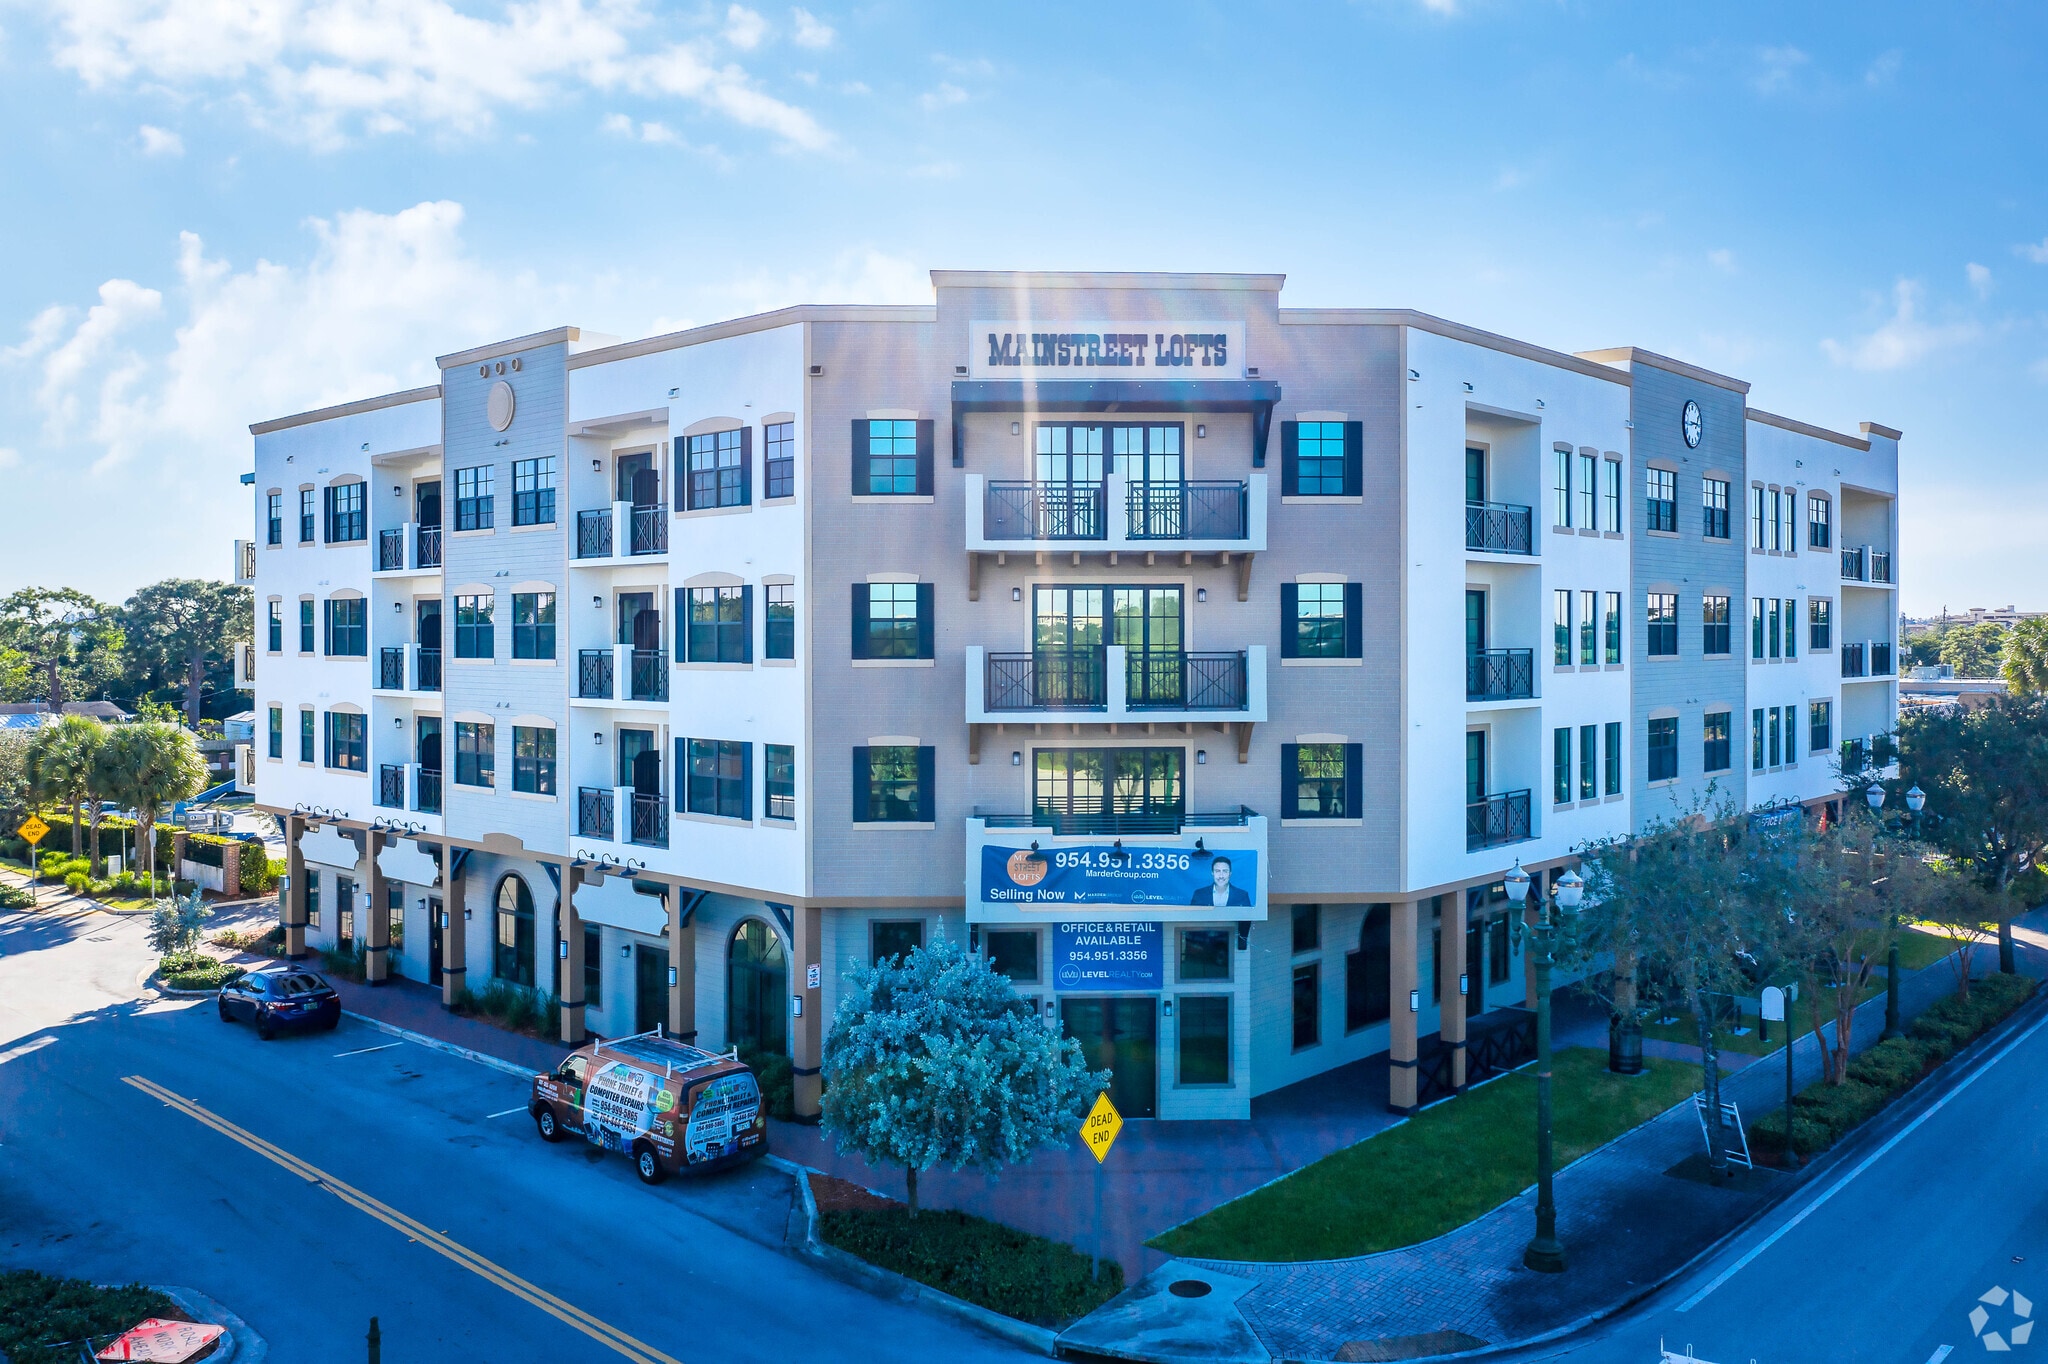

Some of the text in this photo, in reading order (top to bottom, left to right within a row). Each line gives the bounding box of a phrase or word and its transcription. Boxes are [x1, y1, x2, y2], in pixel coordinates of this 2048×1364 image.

[988, 333, 1227, 366] MAINSTREET LOFTS
[1014, 862, 1040, 872] STREET
[1055, 851, 1190, 871] 954.951.3356
[1013, 873, 1041, 881] LOFTS
[1085, 869, 1159, 880] MarderGroup.com
[990, 888, 1065, 903] Selling Now
[1061, 923, 1104, 933] OFFICE
[1114, 922, 1156, 933] RETAIL
[1075, 935, 1142, 946] AVAILABLE
[1069, 950, 1148, 961] 954.951.3356
[589, 1084, 621, 1103] COMPUTER
[619, 1095, 645, 1111] REPAIRS
[1090, 1112, 1113, 1128] DEAD
[1093, 1130, 1110, 1145] END
